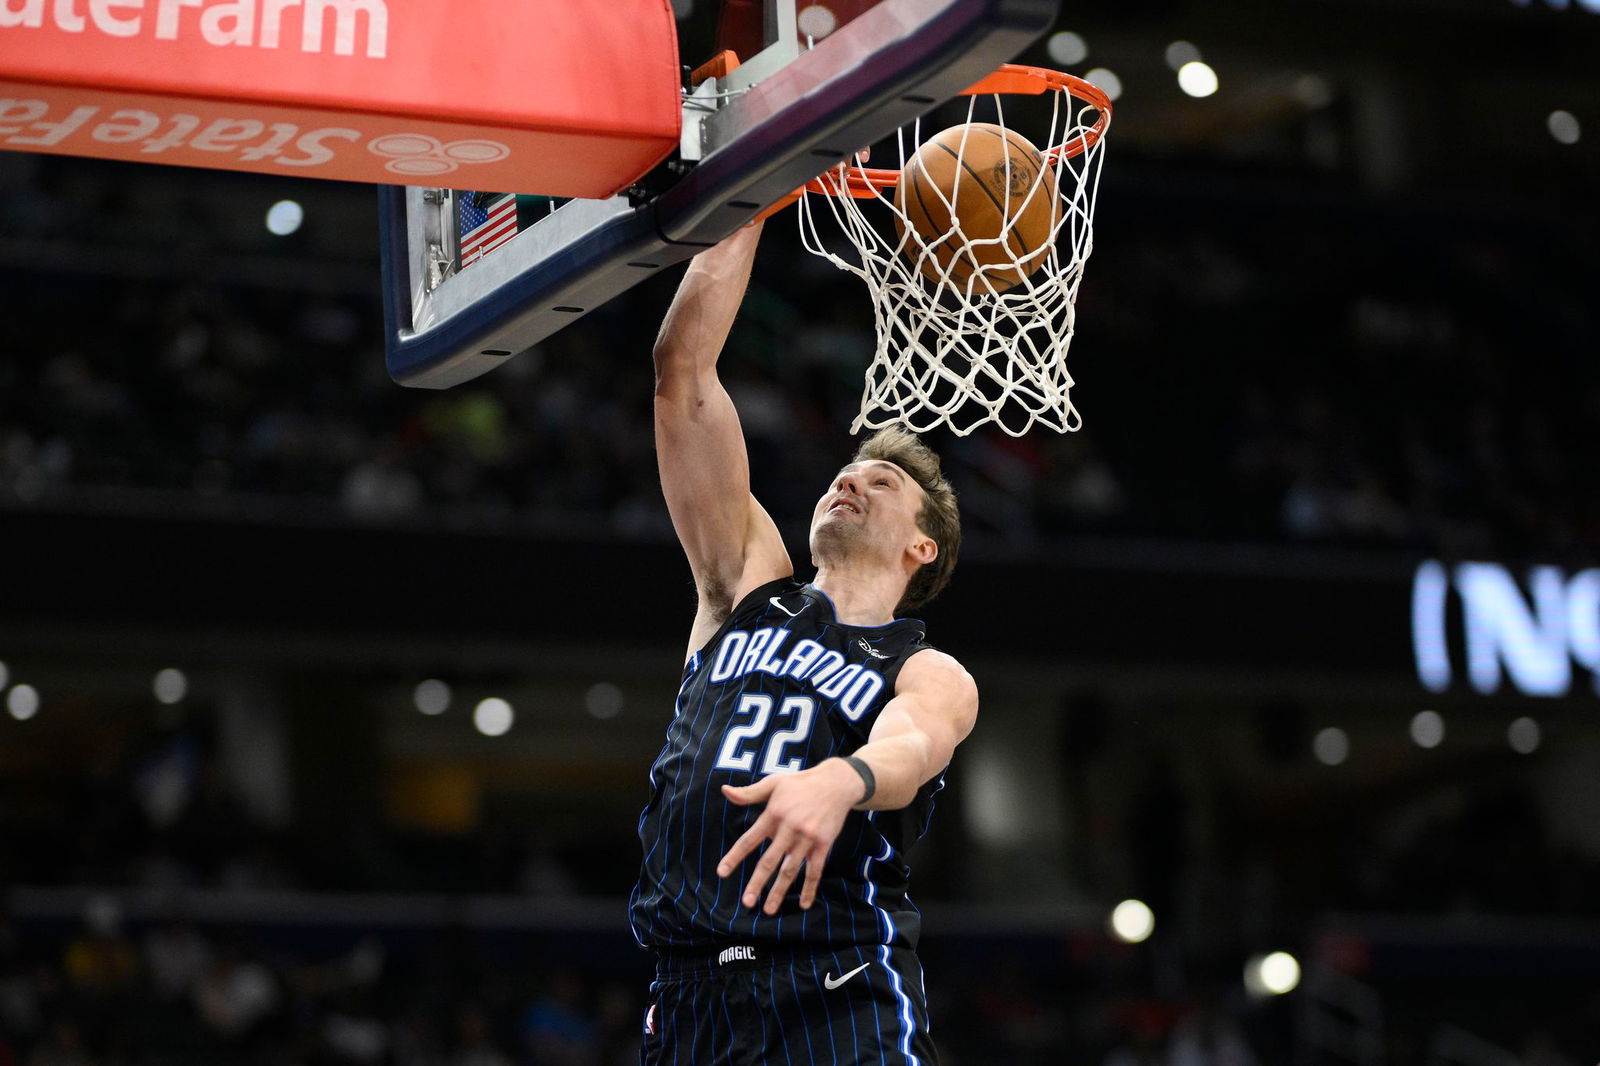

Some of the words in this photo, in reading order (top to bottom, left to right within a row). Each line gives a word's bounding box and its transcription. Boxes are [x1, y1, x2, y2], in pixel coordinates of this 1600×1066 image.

[709, 627, 885, 723] ORLANDO
[714, 692, 815, 774] 22
[718, 945, 757, 967] MAGIC
